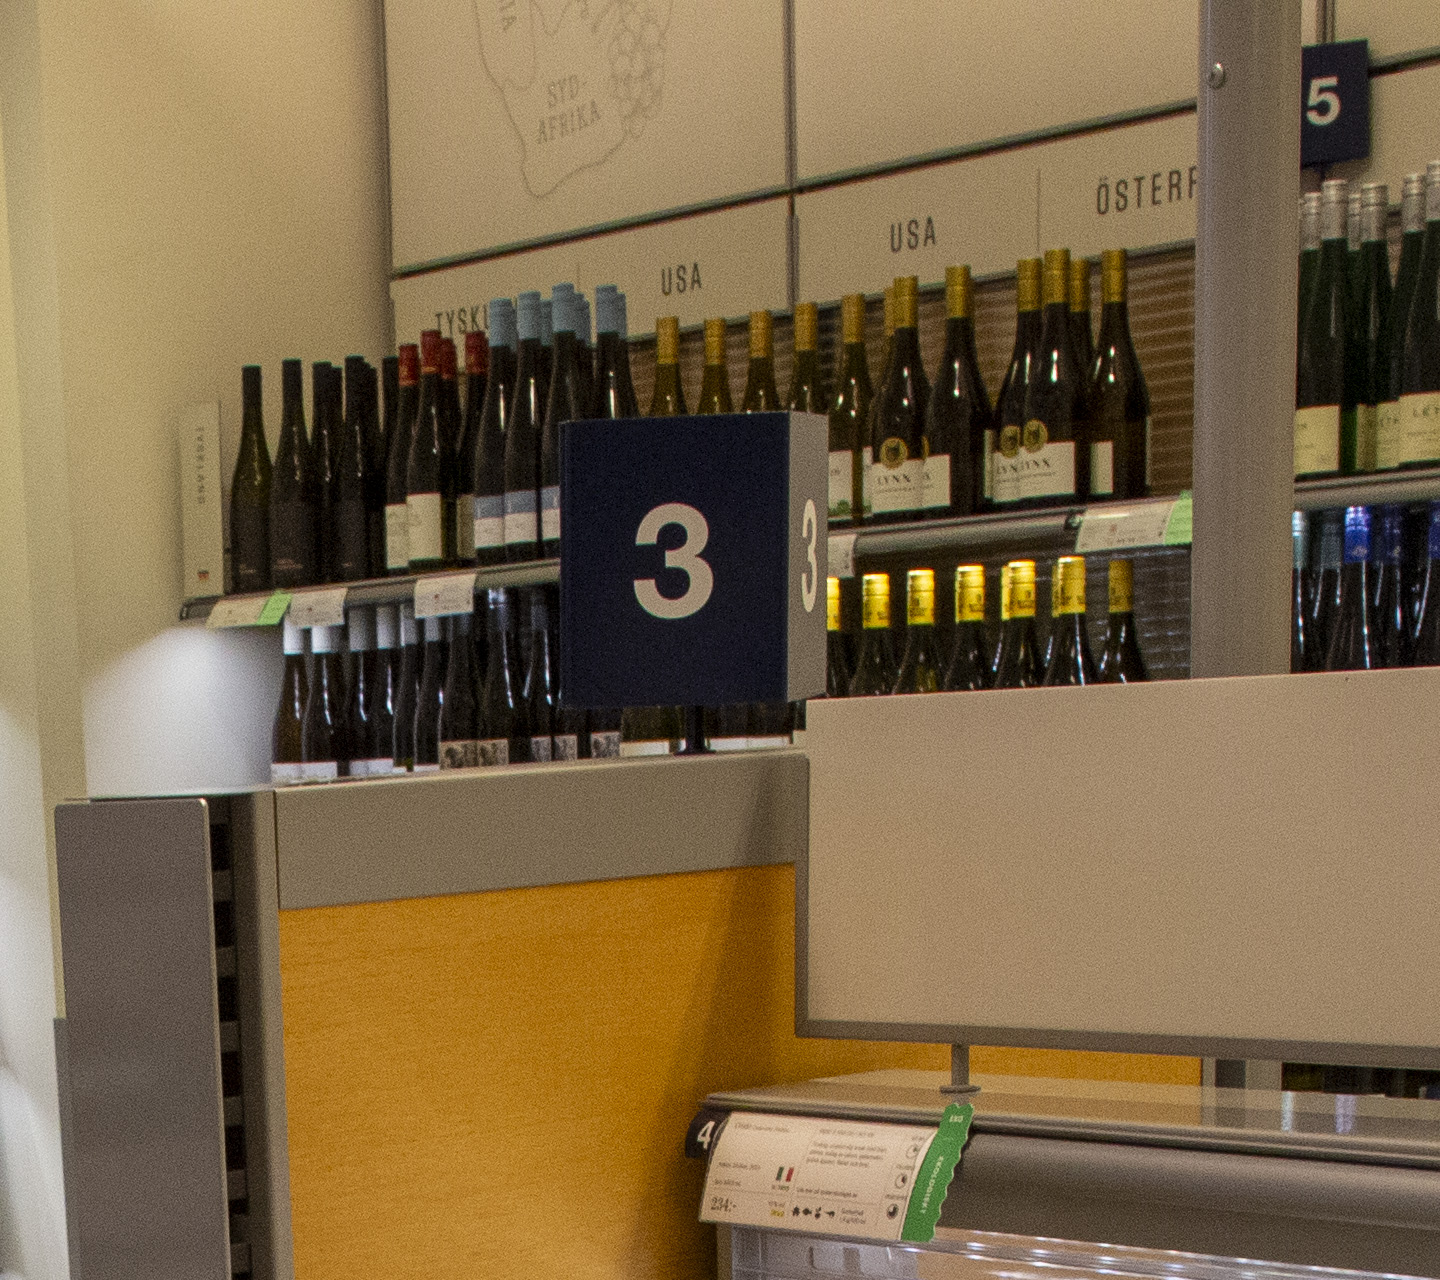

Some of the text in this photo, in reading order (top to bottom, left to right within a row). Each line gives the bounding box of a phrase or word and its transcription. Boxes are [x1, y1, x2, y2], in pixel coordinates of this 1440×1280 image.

[1306, 79, 1341, 126] 5
[890, 215, 938, 254] USA
[661, 262, 703, 296] USA
[633, 503, 714, 620] 3
[801, 499, 820, 614] 3
[697, 1120, 715, 1150] 4
